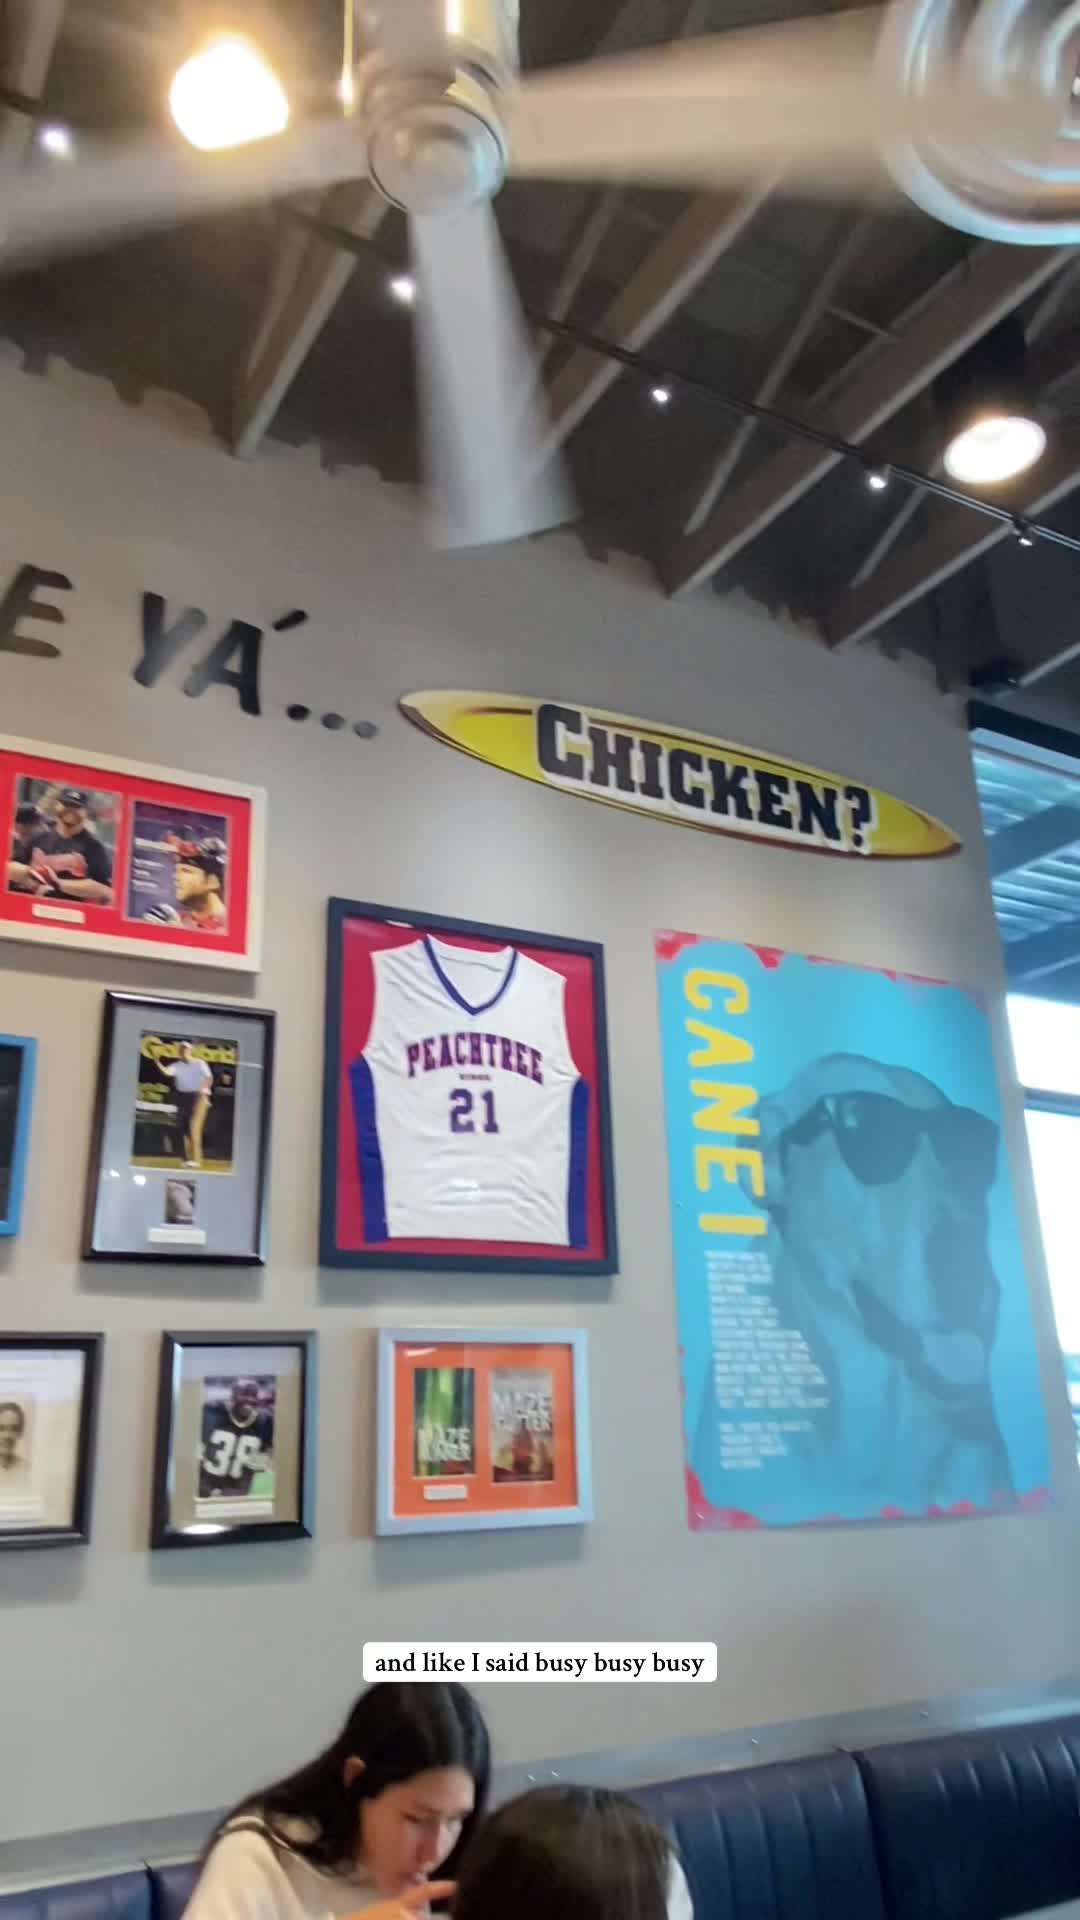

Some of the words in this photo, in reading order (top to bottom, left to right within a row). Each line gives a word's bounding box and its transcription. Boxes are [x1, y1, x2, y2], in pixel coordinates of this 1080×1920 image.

[536, 703, 872, 849] CHICKEN?
[405, 1031, 544, 1086] PEACHTREE
[449, 1088, 500, 1134] 21
